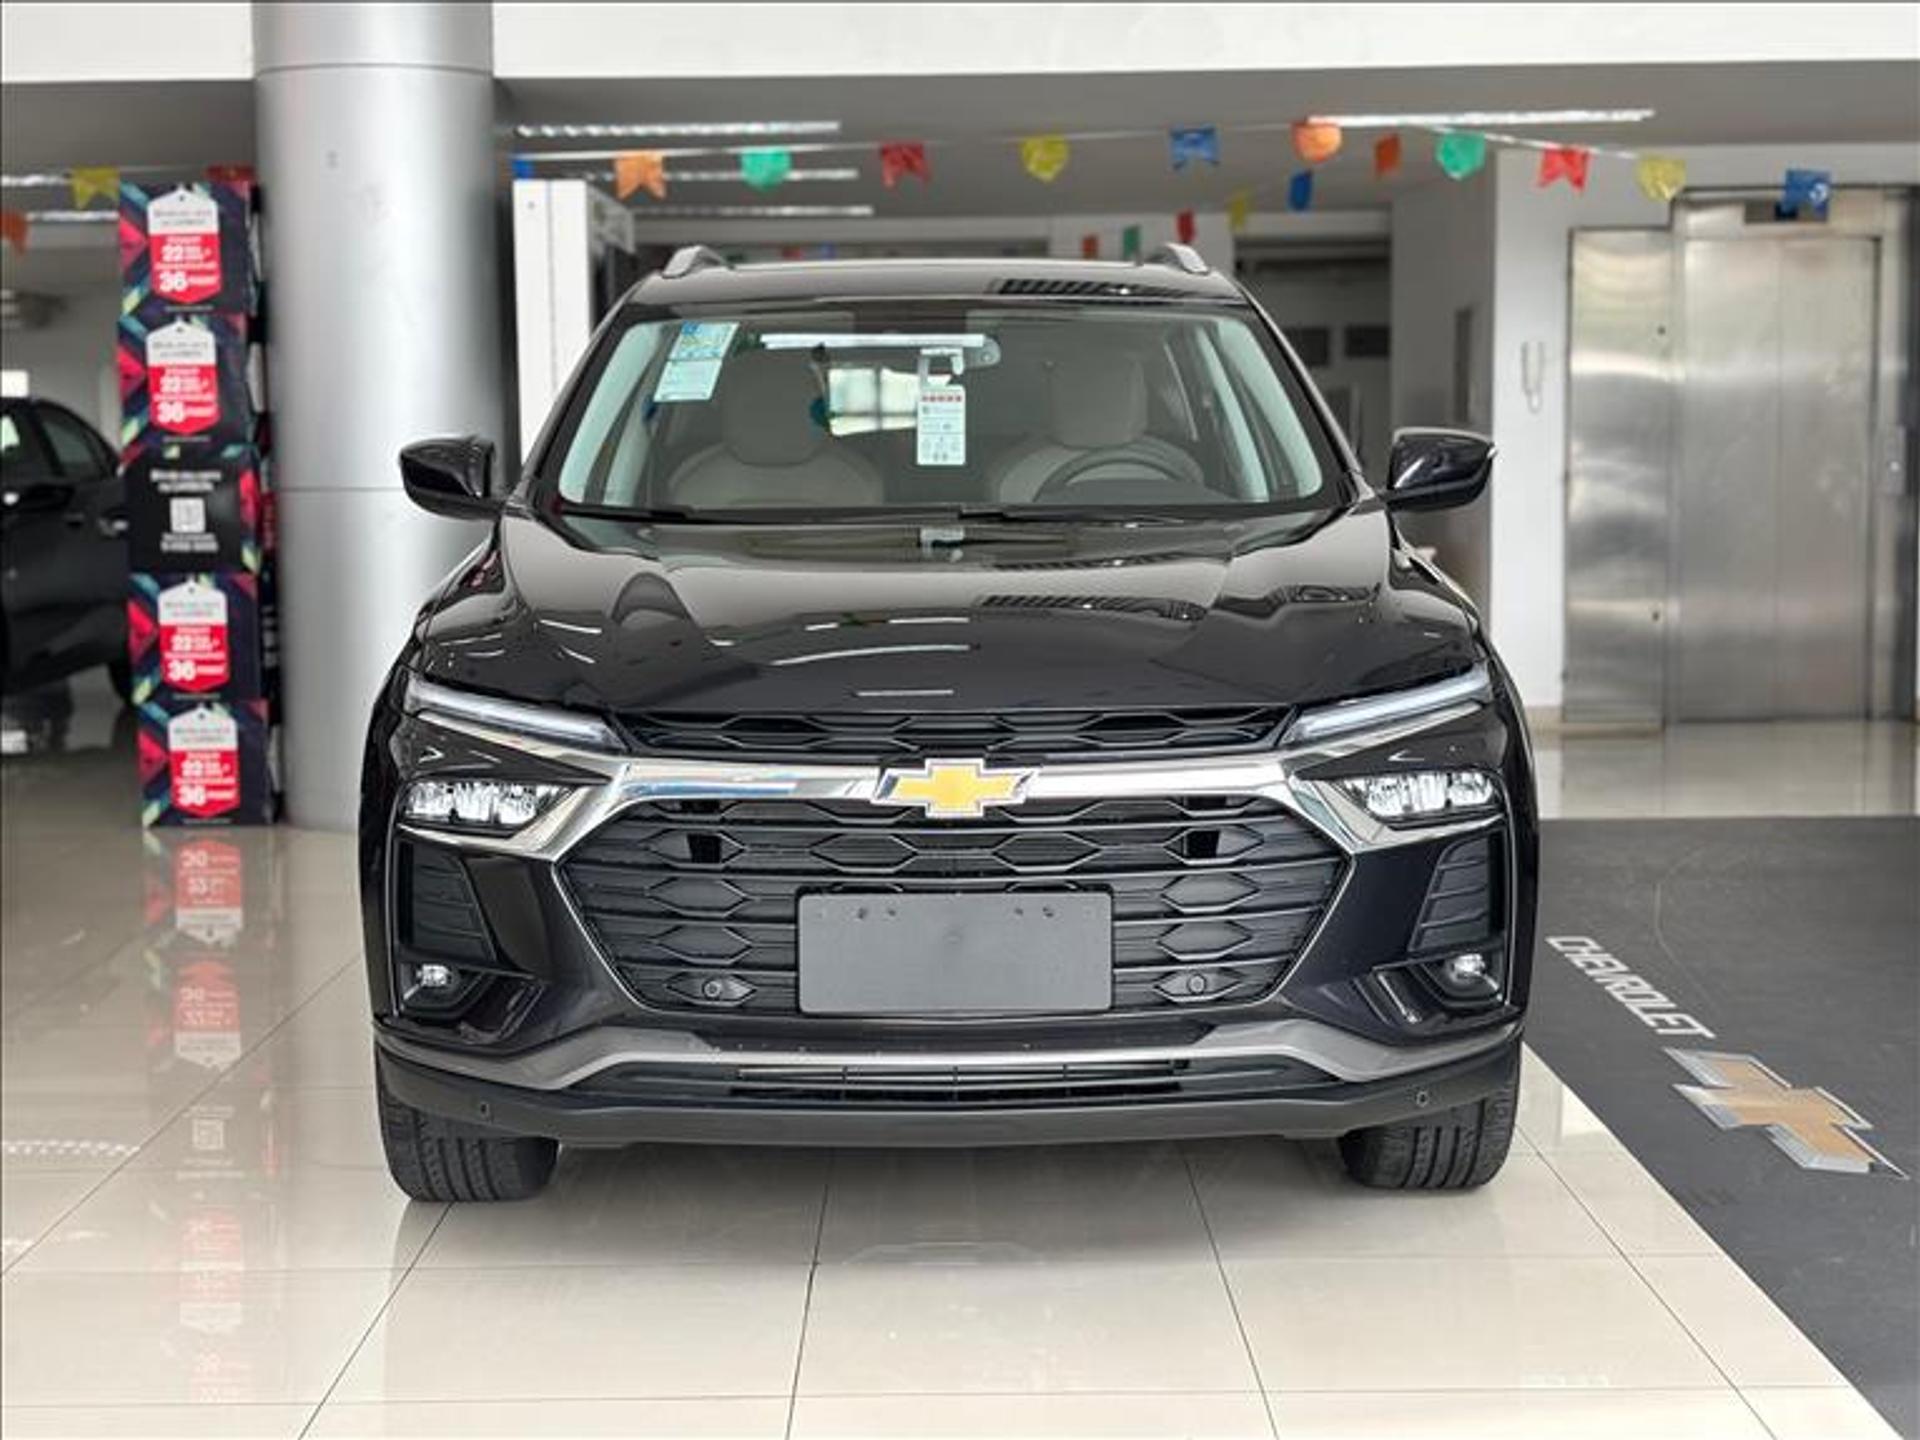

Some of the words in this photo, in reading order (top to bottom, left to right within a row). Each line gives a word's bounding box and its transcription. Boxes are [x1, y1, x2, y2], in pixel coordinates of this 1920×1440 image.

[161, 245, 183, 262] 22
[159, 271, 188, 292] 36
[1545, 936, 1715, 1038] CHEVROLET
